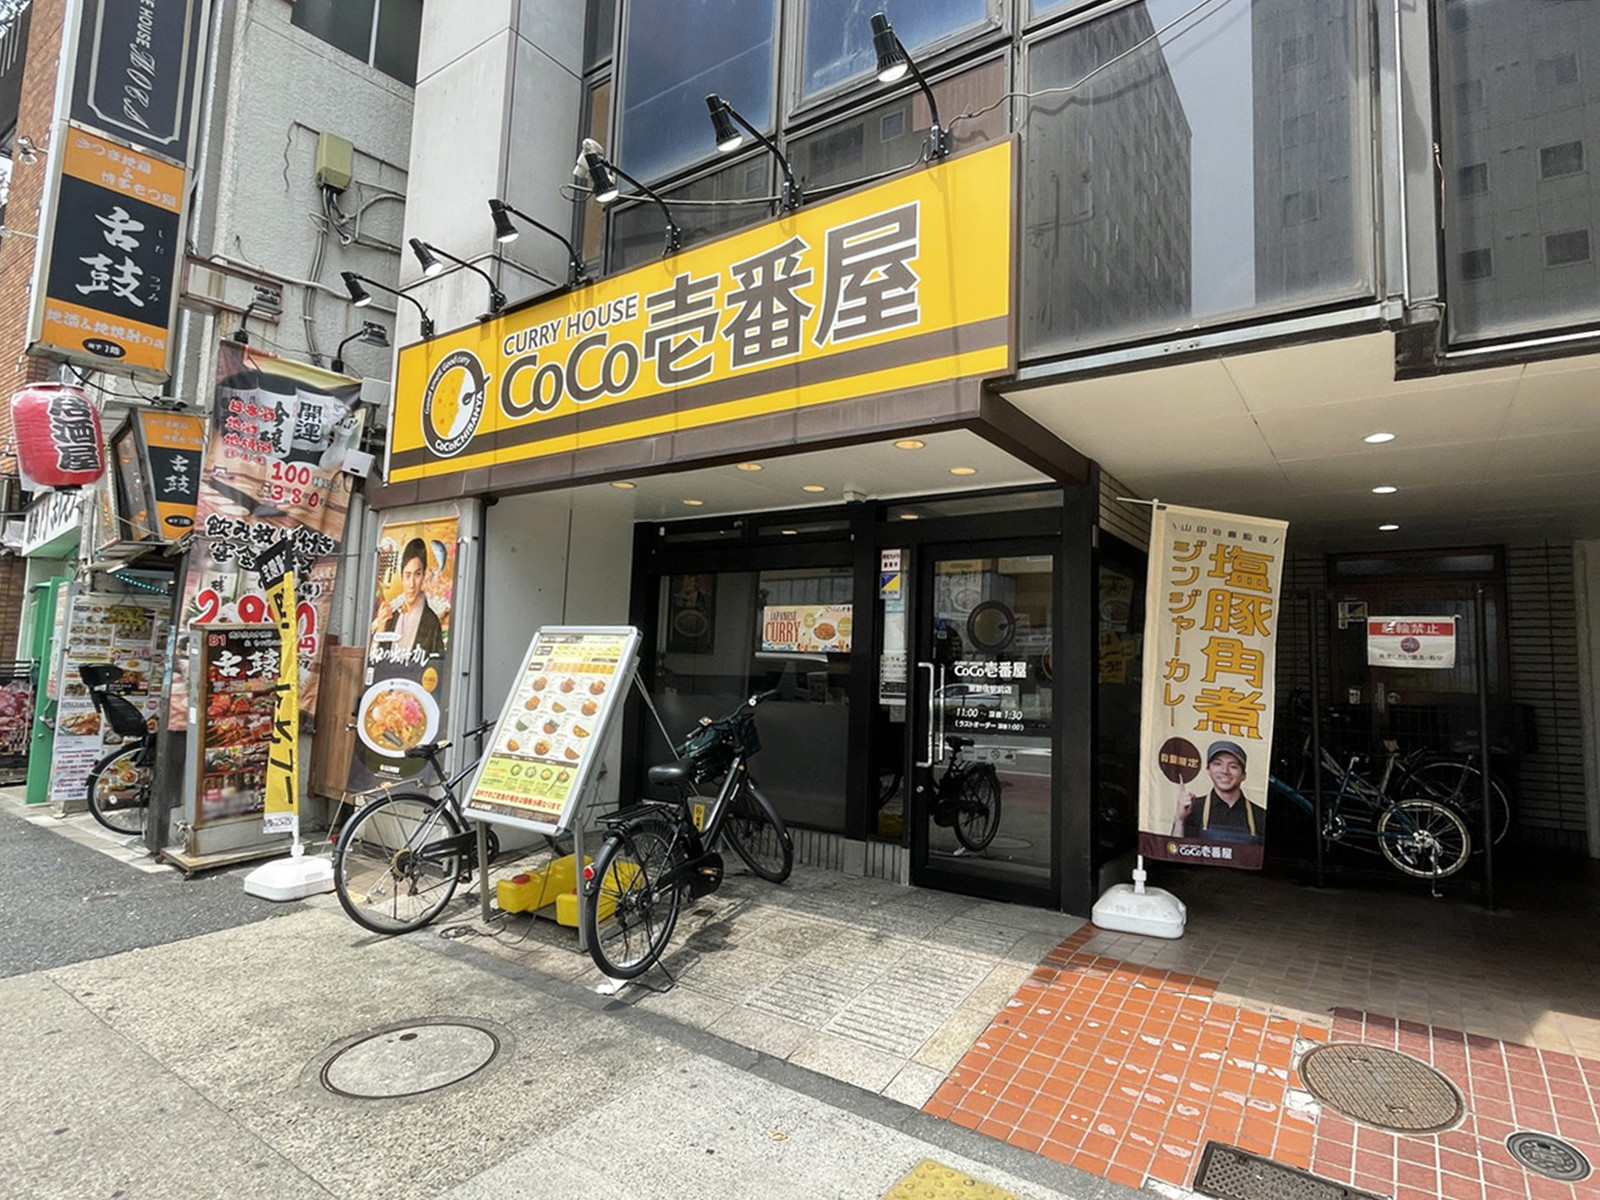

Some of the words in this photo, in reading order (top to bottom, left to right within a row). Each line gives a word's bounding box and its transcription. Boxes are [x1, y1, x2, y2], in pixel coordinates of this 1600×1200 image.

[136, 6, 154, 49] HOUSE
[503, 318, 560, 358] CURRY
[566, 293, 638, 337] HOUSE
[49, 394, 101, 472] 居酒屋
[294, 402, 323, 444] 開運
[765, 620, 801, 643] CURRY
[769, 611, 797, 621] JAPANESE
[1162, 539, 1207, 727] ジンジャーカレー
[208, 634, 227, 646] B1
[1192, 542, 1275, 740] 塩豚角煮
[954, 661, 1027, 678] CoCo壱番屋
[956, 707, 979, 718] 11:00
